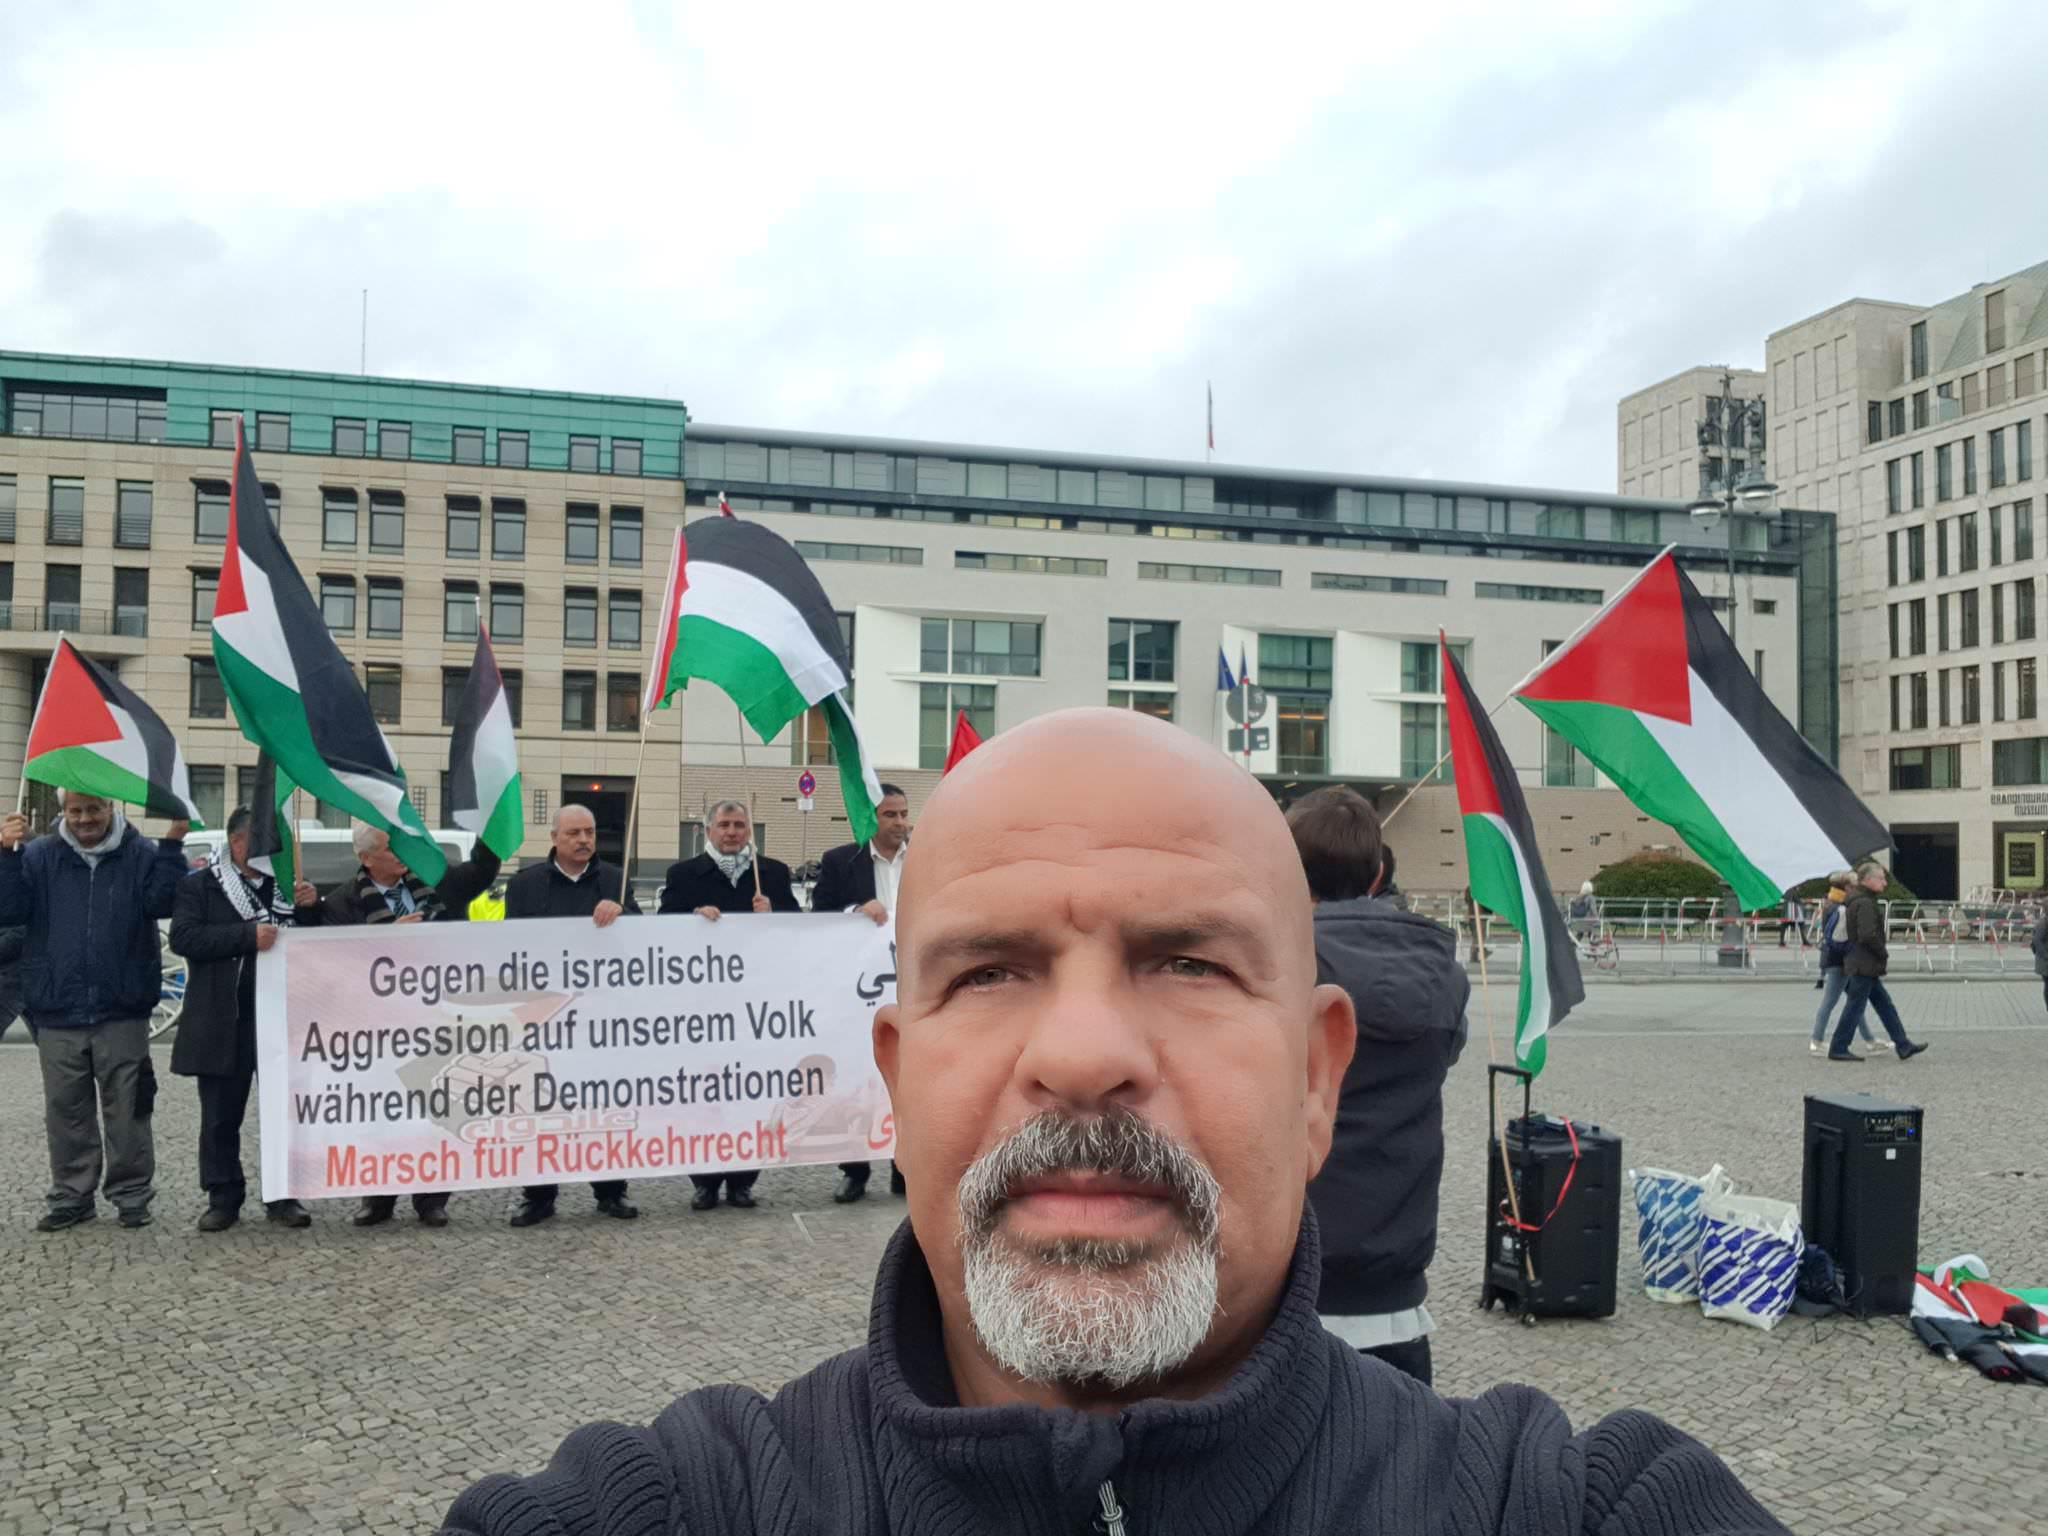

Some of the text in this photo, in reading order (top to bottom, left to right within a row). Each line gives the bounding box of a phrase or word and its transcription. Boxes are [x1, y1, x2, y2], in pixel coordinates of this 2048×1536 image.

[369, 946, 745, 1005] Gegen die israelische
[301, 1000, 817, 1072] Aggression auf unserem Volk
[295, 1062, 825, 1124] während der Demonstrationen
[326, 1120, 788, 1187] Marsch für Rückkehrrecht
